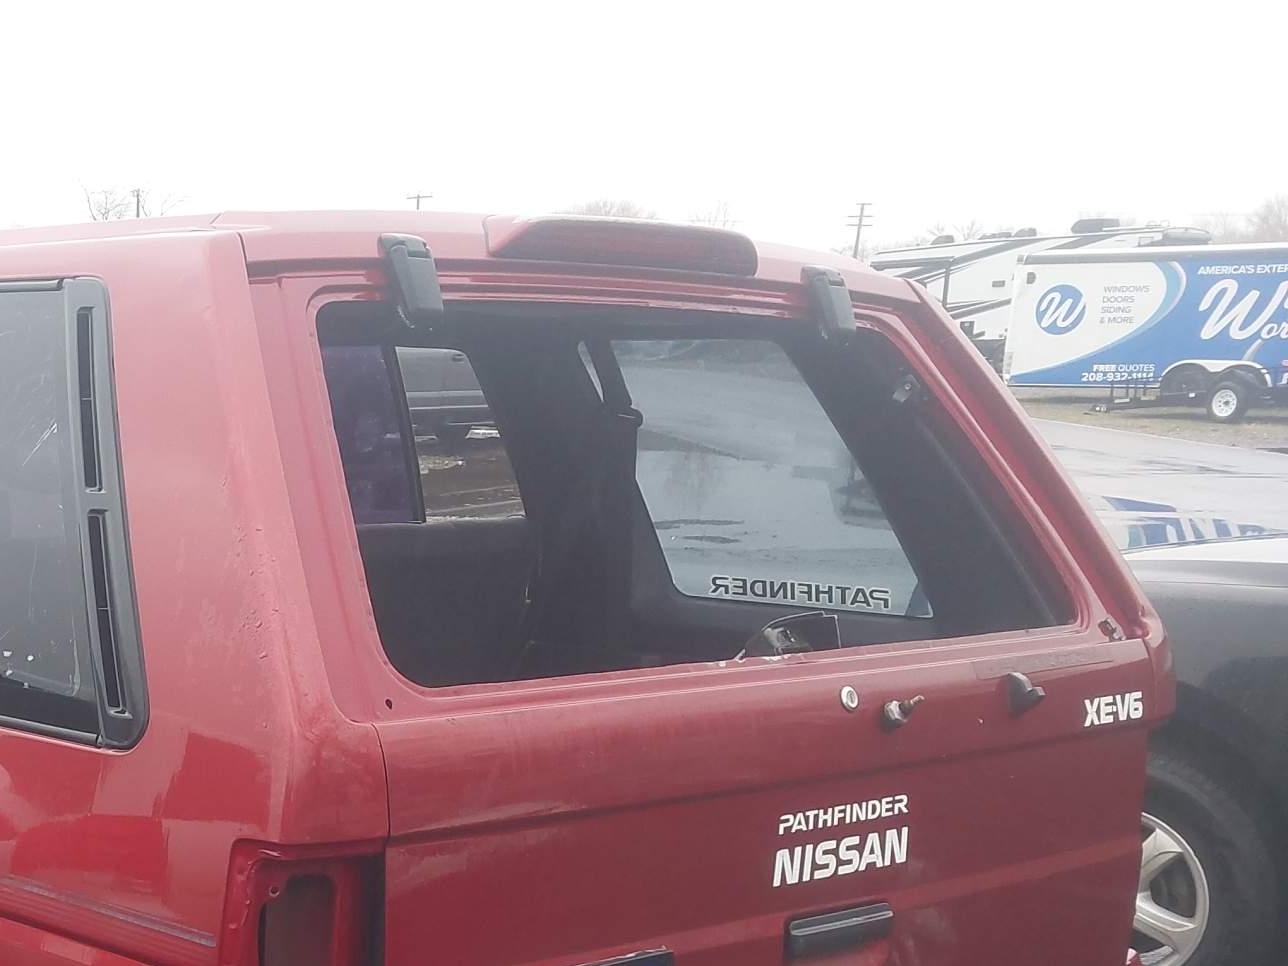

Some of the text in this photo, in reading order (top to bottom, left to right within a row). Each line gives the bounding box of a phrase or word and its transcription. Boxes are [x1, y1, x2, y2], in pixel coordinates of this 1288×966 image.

[1197, 263, 1288, 275] AMERICA'S EXTE
[1103, 285, 1151, 294] WINDOWS
[1102, 295, 1136, 304] DOORS
[1040, 292, 1084, 328] W
[1100, 305, 1132, 314] SIDING
[1107, 316, 1135, 324] MORE
[1092, 363, 1156, 372] FREE QUOTES
[777, 794, 909, 836] PATHFINDER
[772, 826, 909, 888] NISSAN
